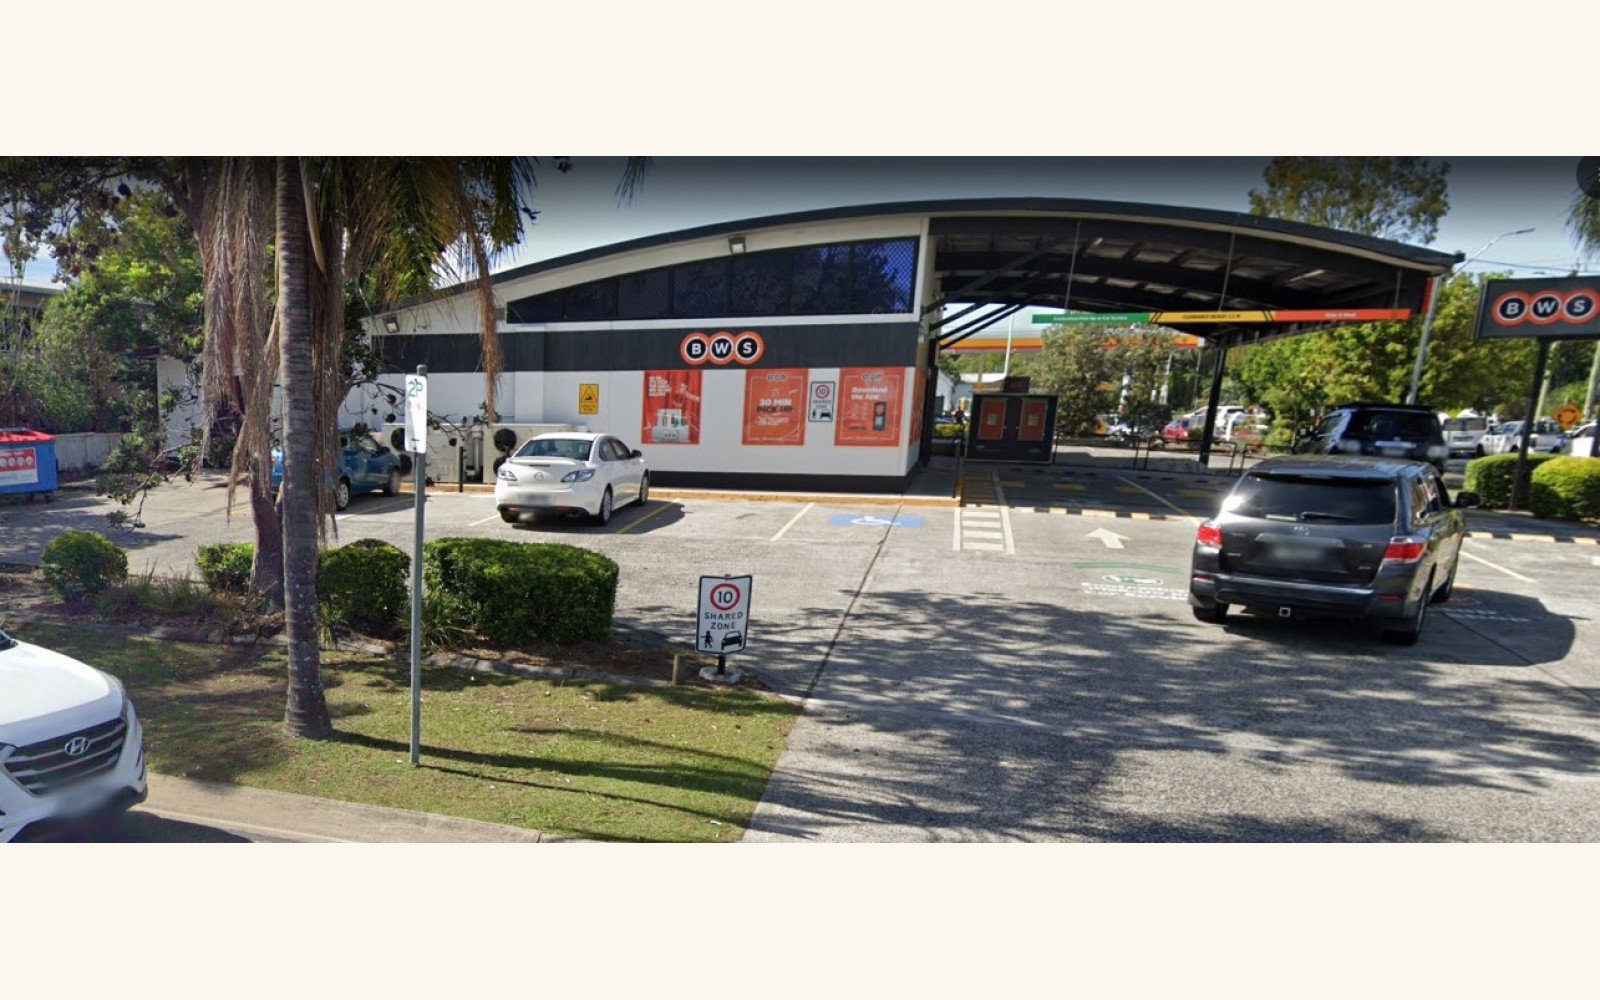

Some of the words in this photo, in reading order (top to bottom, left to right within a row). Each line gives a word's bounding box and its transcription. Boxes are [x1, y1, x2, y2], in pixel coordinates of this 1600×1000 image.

[408, 379, 423, 397] 2P
[718, 591, 733, 604] 10
[704, 611, 743, 621] SHARED
[710, 621, 736, 630] ZONE
